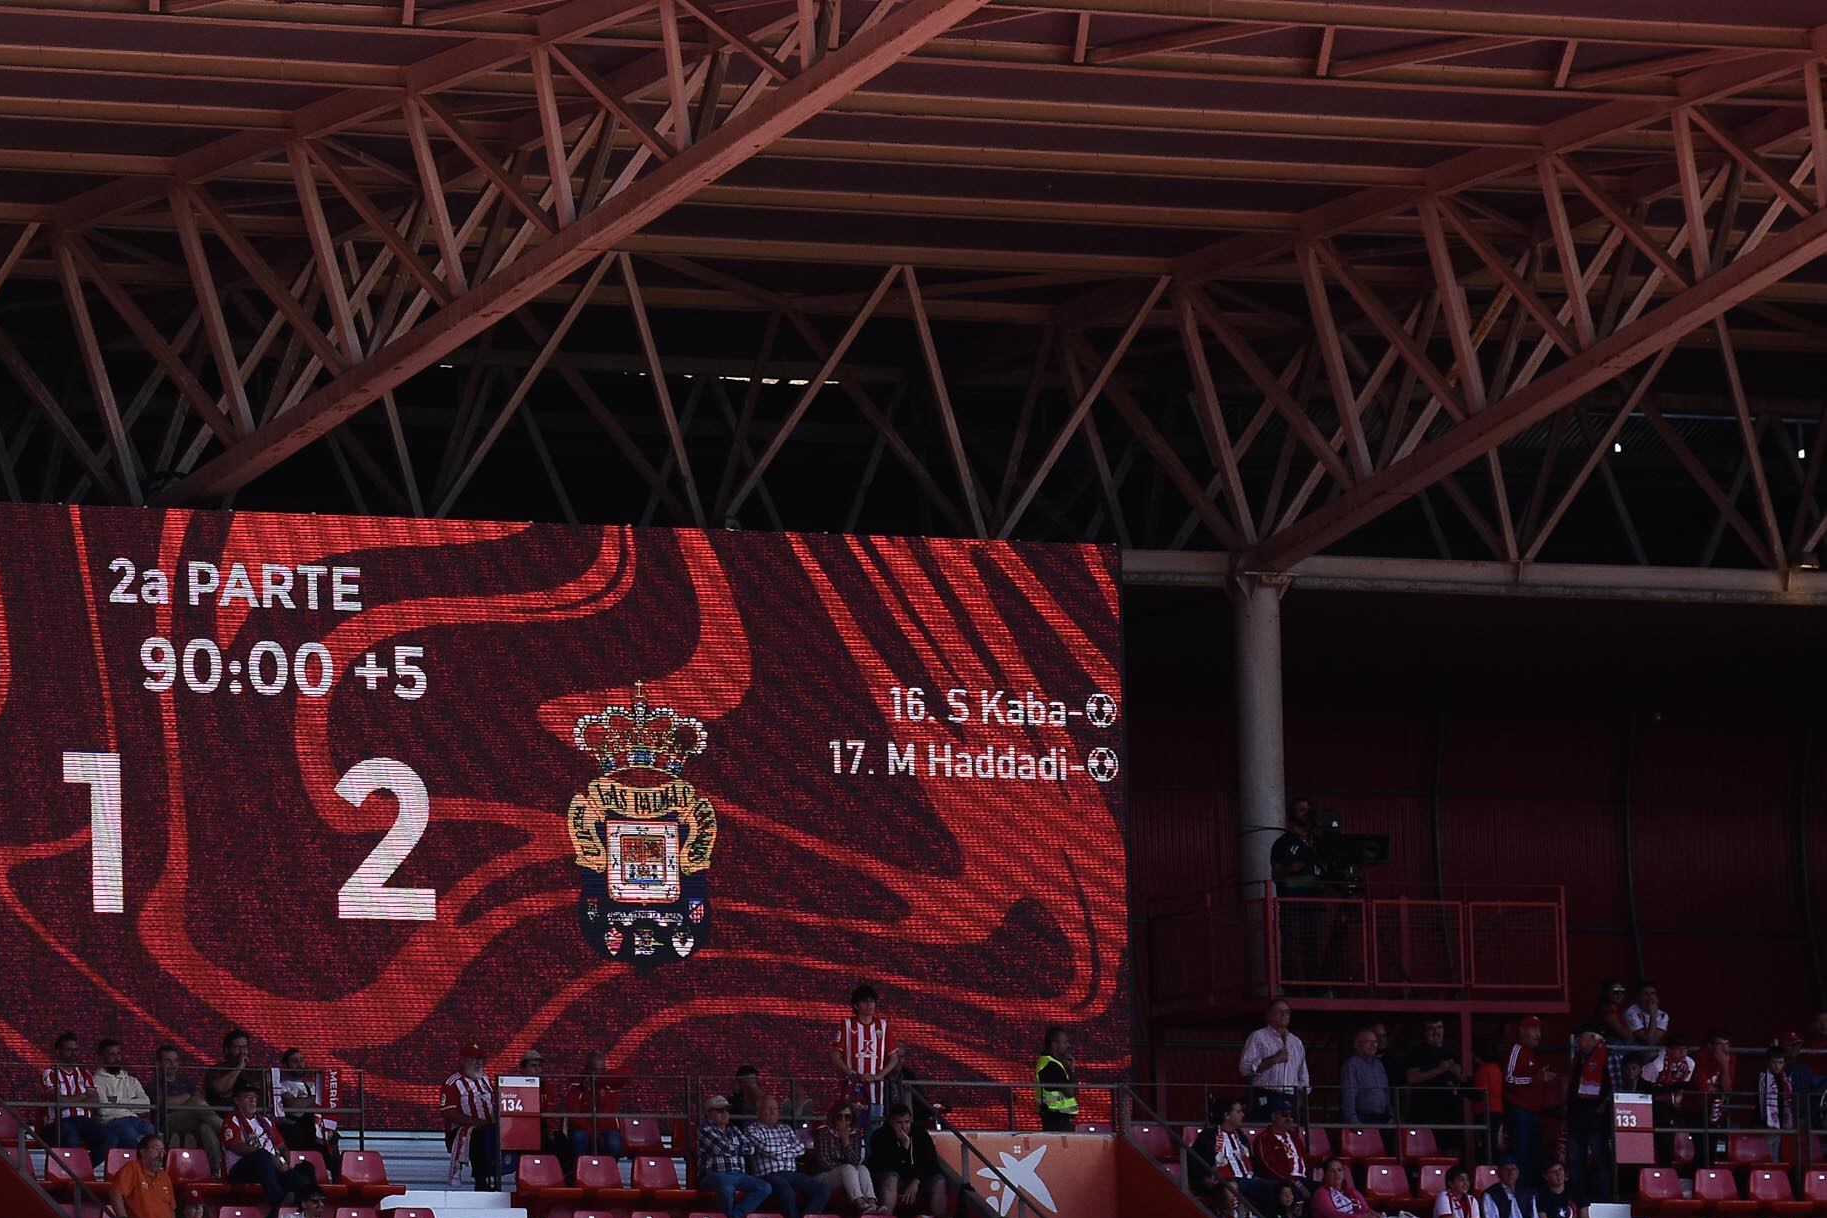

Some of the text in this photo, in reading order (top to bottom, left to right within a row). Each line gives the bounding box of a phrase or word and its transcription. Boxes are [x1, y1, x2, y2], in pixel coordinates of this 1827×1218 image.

[109, 557, 362, 611] 2a PARTE
[140, 637, 427, 700] 90:00 +5
[891, 687, 935, 722] 16.
[947, 688, 969, 723] S
[829, 740, 873, 775] 17.
[888, 742, 916, 775] M
[62, 752, 124, 913] 1
[334, 757, 436, 920] 2
[329, 1069, 339, 1109] MERÍA
[501, 1099, 523, 1112] 134
[1616, 1115, 1637, 1127] 133
